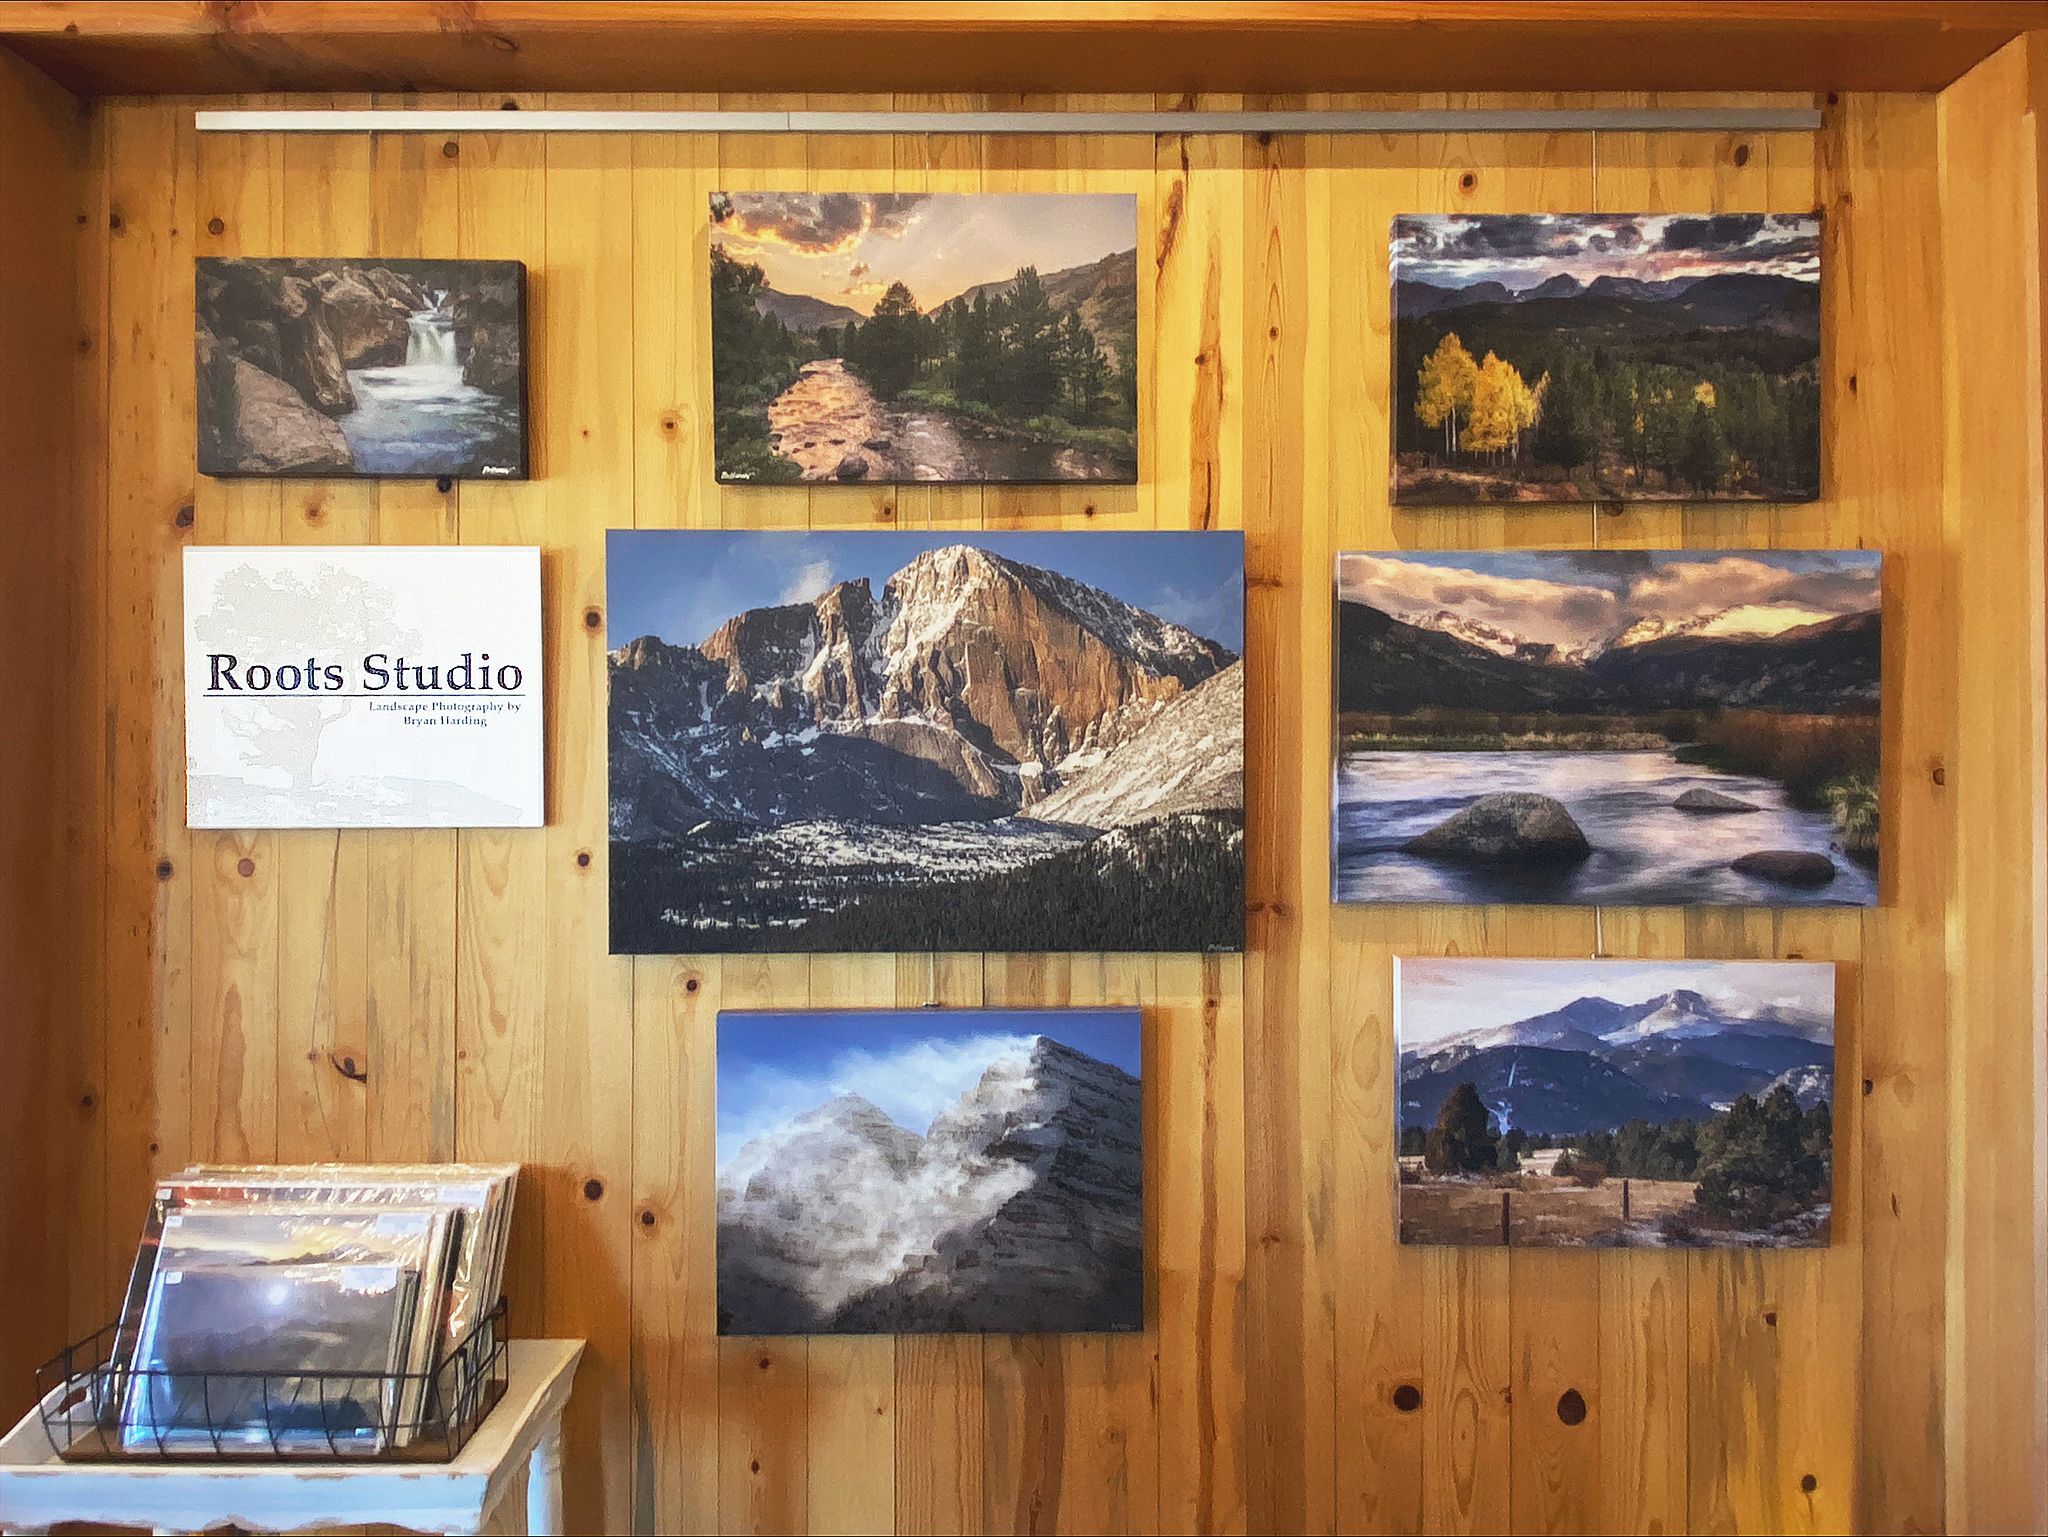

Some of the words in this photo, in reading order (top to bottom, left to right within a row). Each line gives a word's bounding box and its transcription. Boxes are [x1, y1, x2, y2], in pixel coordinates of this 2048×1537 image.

[206, 652, 344, 691] Roots
[363, 652, 523, 691] Studio
[369, 701, 429, 714] Landscape
[431, 701, 504, 714] Photography
[506, 701, 521, 714] by
[403, 715, 437, 728] Bryan
[440, 715, 488, 728] Harding
